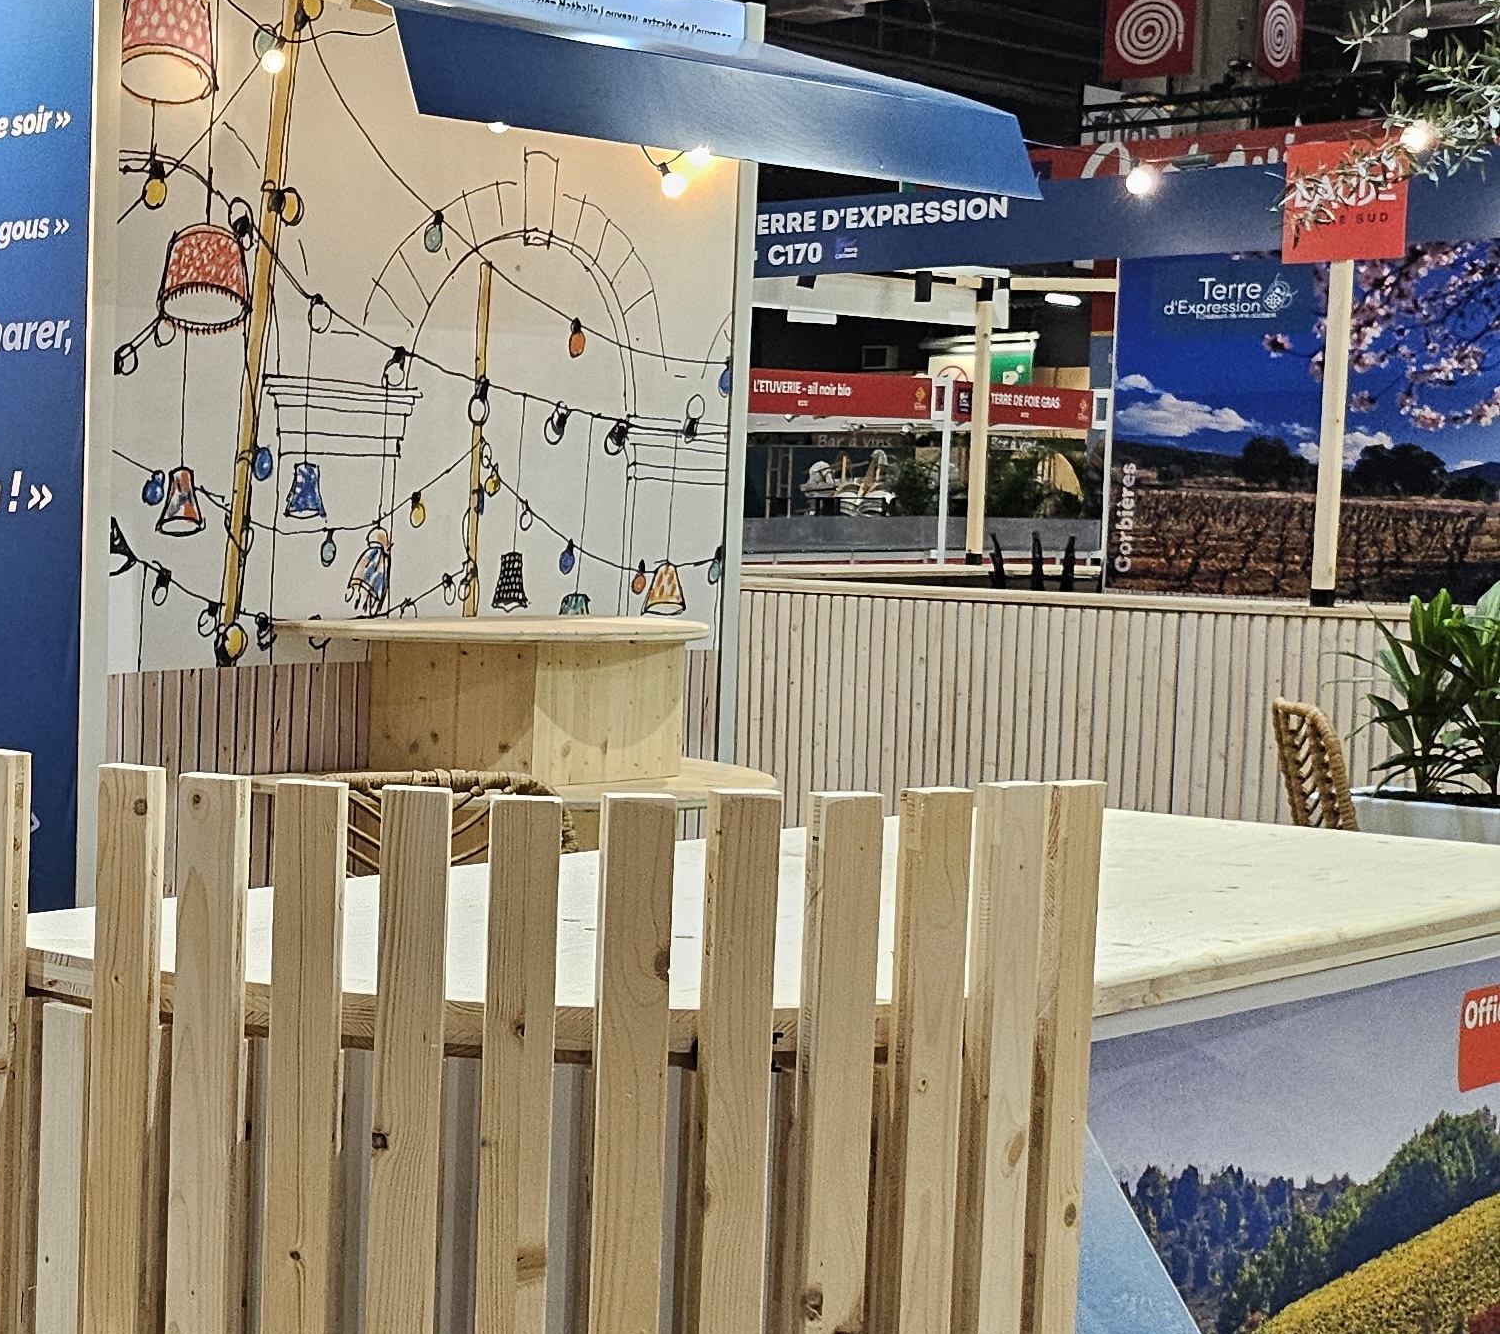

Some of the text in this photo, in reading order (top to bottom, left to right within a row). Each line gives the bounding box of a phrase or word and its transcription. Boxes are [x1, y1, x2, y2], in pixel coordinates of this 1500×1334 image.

[11, 105, 54, 134] soir
[822, 197, 1008, 232] D'EXPRESSION
[767, 242, 822, 266] C170
[1198, 277, 1262, 301] Terre
[1163, 299, 1261, 316] d'Expression
[1114, 463, 1137, 572] Corbières
[1465, 994, 1500, 1029] Offi
